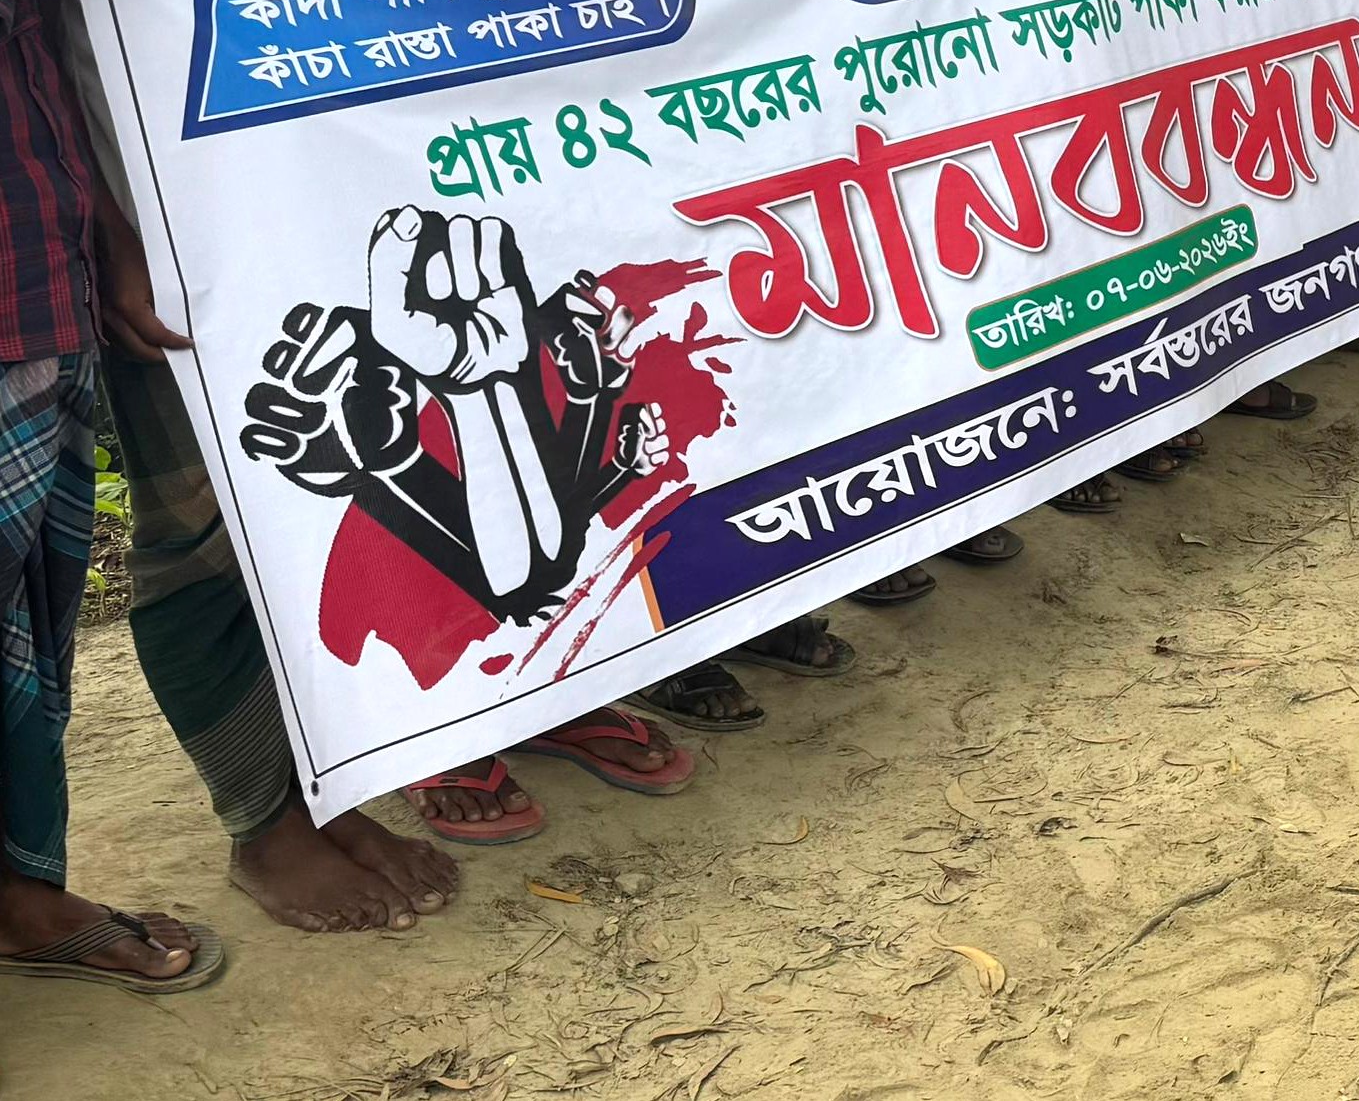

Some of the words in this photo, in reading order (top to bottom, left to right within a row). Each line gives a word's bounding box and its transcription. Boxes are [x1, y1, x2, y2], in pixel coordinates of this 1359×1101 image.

[238, 40, 352, 90] কাঁচা
[355, 22, 457, 70] রাস্তা
[467, 2, 563, 48] পাকা
[426, 115, 542, 202] প্রায়
[555, 97, 652, 169] ৪২
[643, 54, 822, 145] বছরের
[833, 7, 1001, 116] পুরোনো
[1085, 219, 1253, 313] ০৭-০৬-২০২৬ইং
[1088, 316, 1257, 399] সর্বস্তরের
